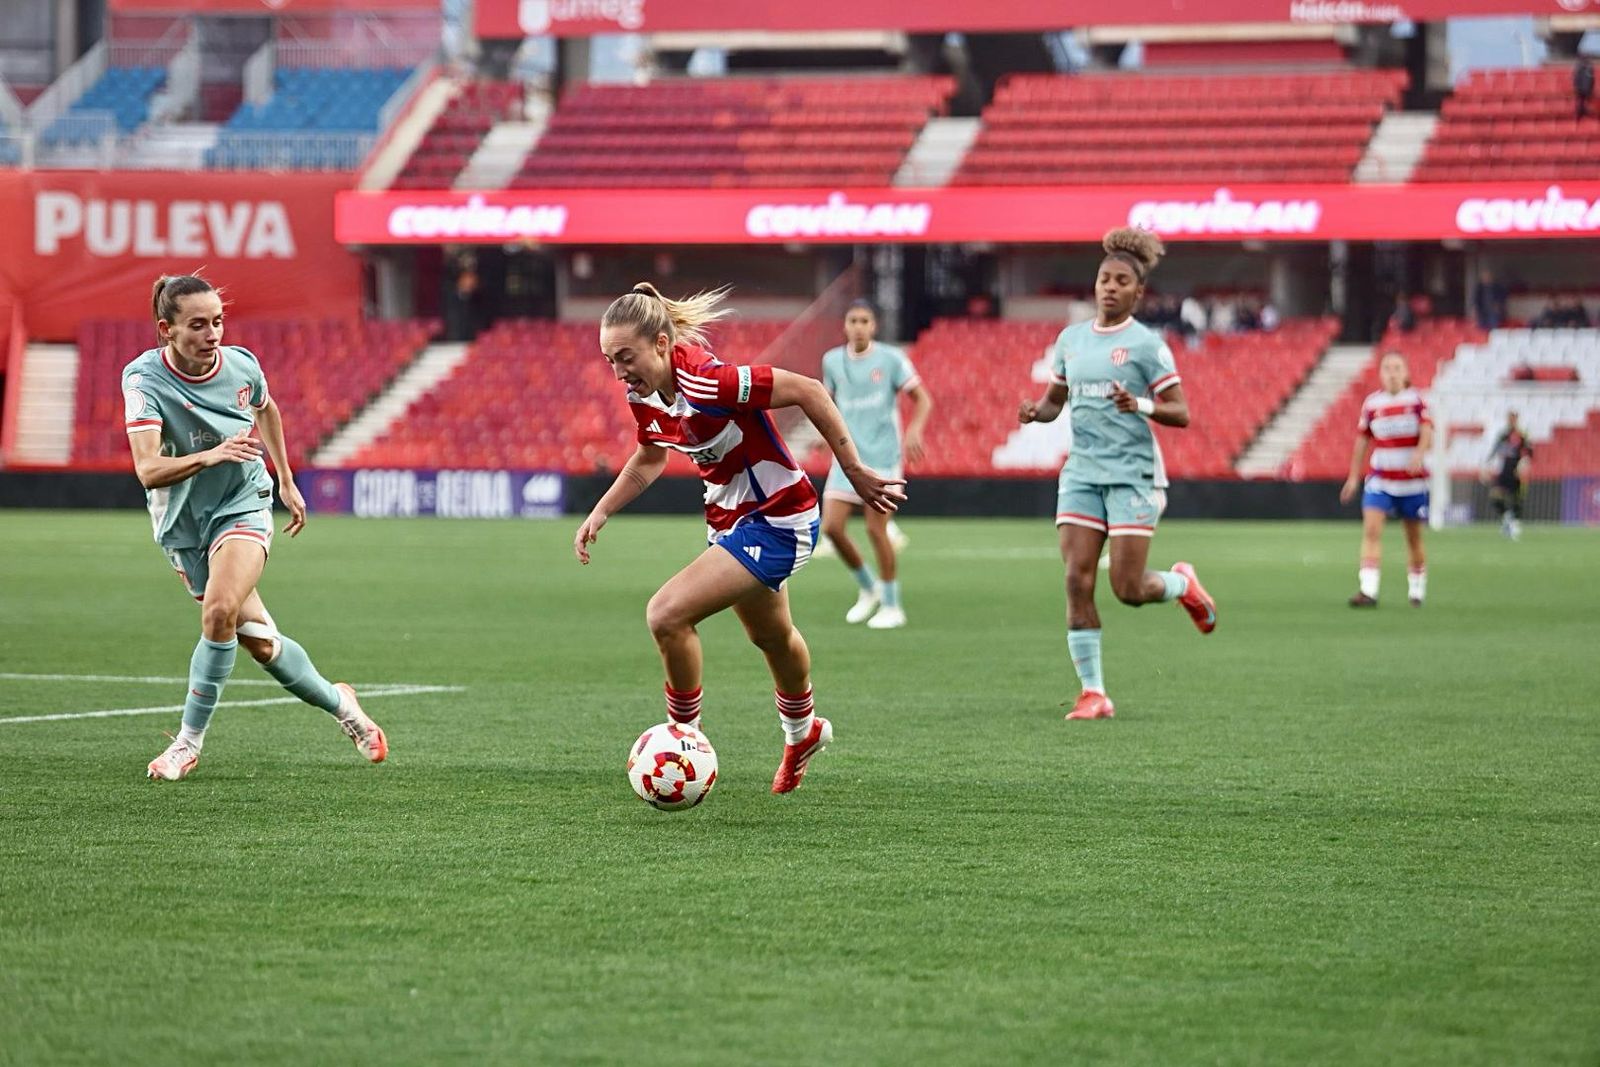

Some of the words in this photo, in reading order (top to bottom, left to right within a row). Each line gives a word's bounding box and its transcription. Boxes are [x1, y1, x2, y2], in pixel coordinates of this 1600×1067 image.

[34, 189, 297, 259] PULEVA
[353, 469, 418, 518] COPA
[436, 470, 514, 518] REINA
